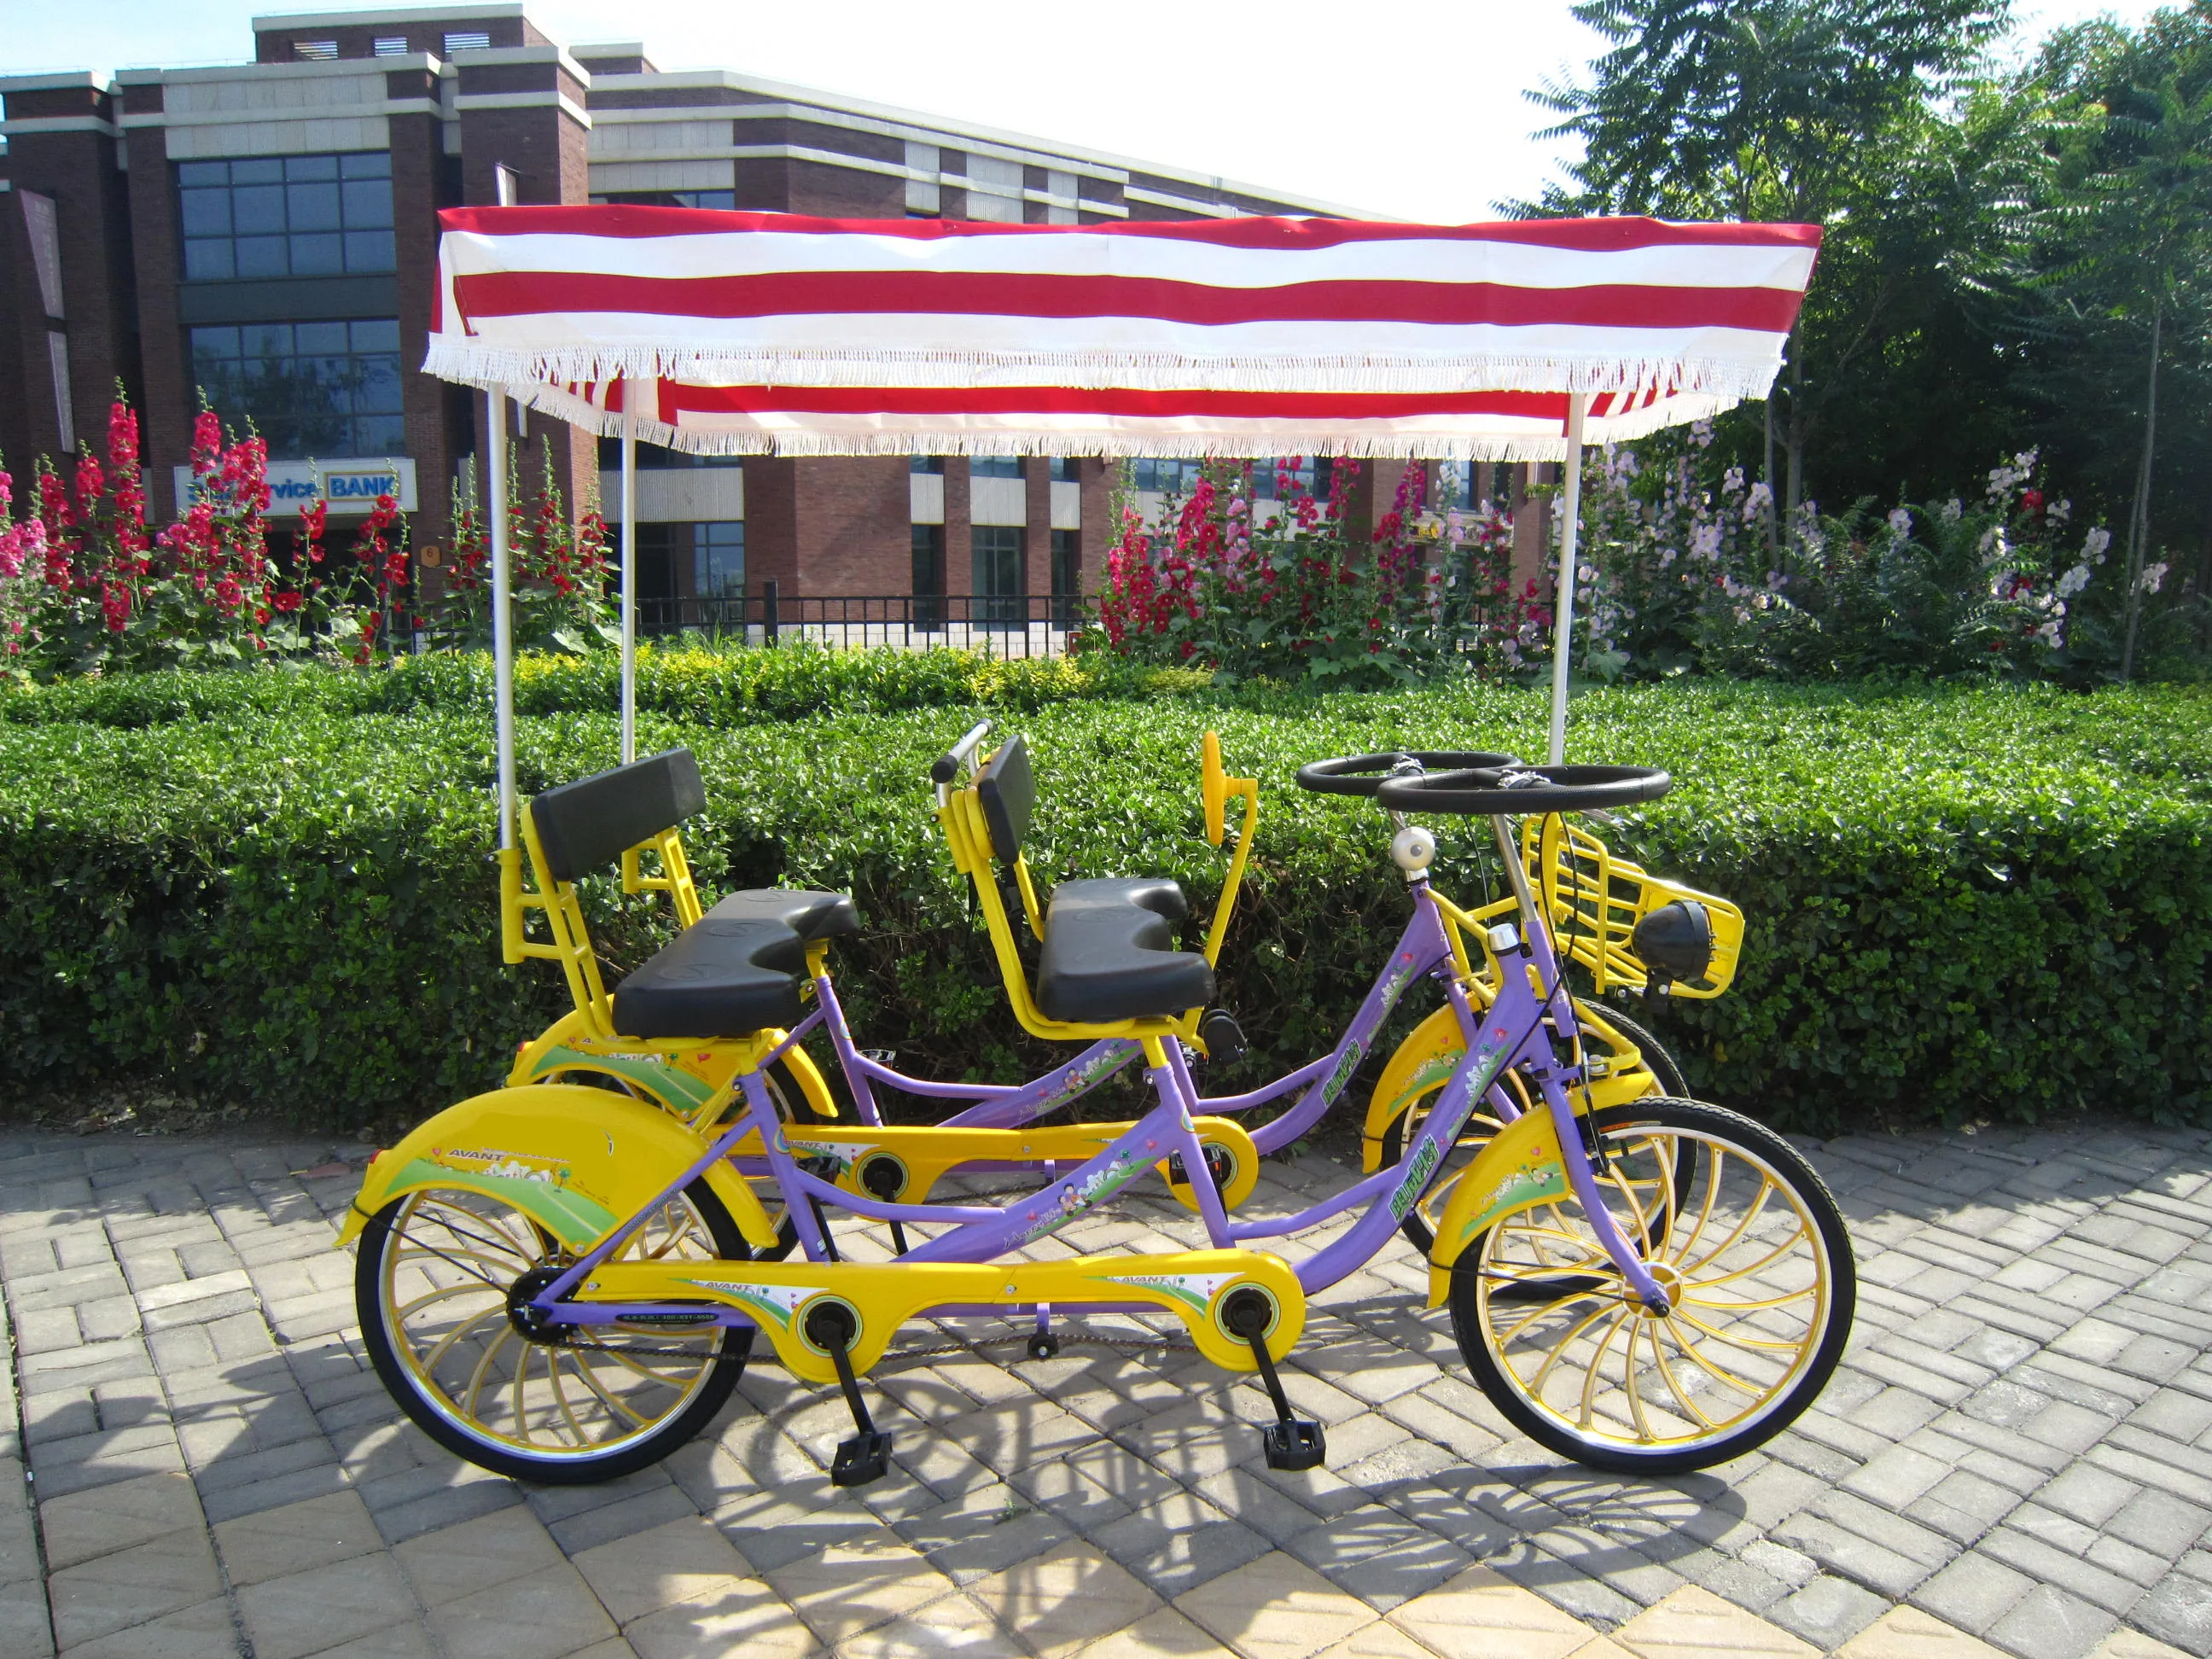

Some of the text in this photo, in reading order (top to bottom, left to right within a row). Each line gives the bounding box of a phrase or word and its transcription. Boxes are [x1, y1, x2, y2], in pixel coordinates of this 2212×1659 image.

[330, 476, 395, 497] BANK
[448, 1148, 506, 1161] AVANT
[704, 1282, 752, 1291] AVANT
